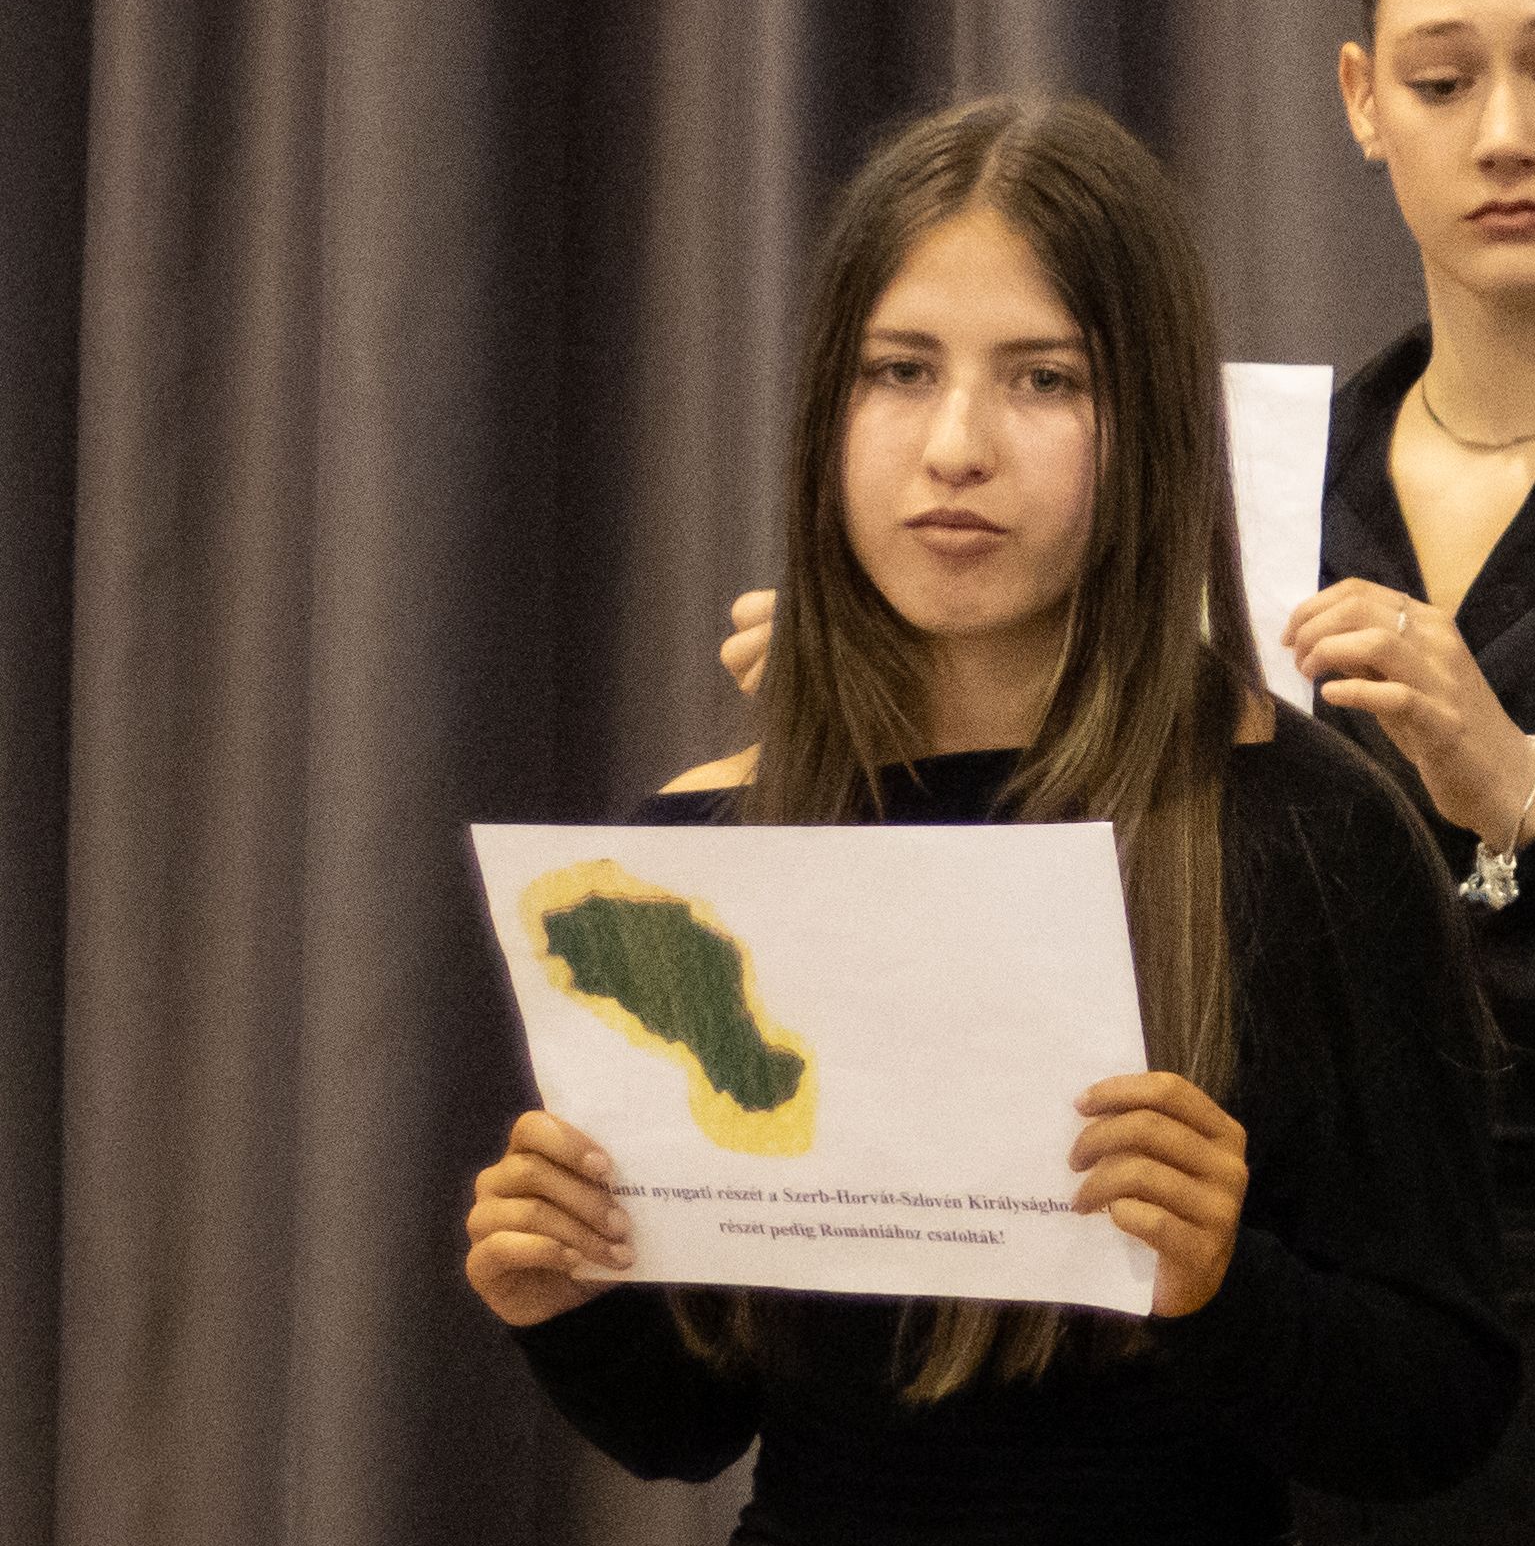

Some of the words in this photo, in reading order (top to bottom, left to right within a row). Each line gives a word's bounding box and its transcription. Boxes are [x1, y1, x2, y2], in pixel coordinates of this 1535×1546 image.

[651, 1185, 712, 1202] nyugati
[718, 1185, 762, 1202] részét
[769, 1191, 778, 1202] a
[968, 1193, 1072, 1217] Királyságho
[719, 1220, 765, 1235] részét
[770, 1222, 816, 1240] pedig
[820, 1223, 921, 1240] Romániához
[927, 1229, 1006, 1245] csatolták!
